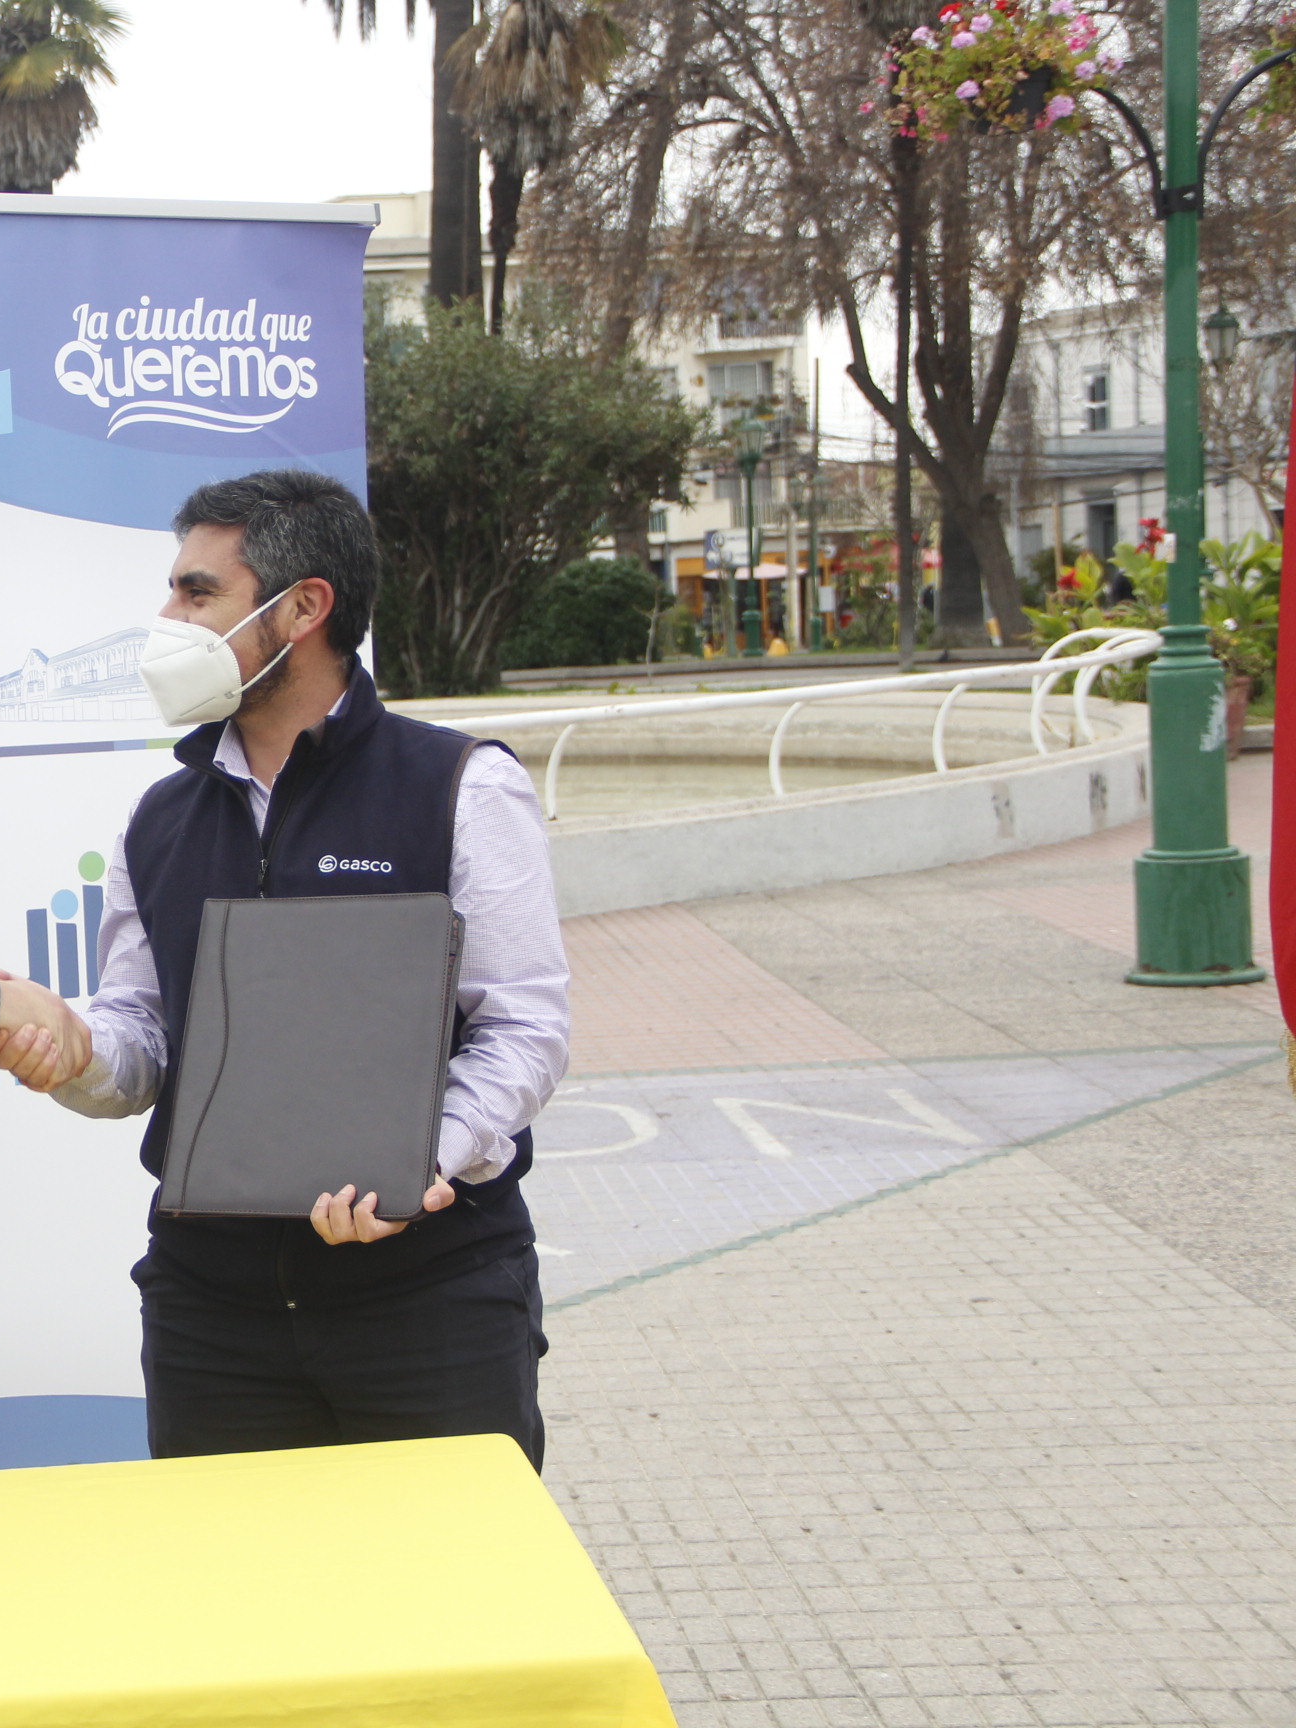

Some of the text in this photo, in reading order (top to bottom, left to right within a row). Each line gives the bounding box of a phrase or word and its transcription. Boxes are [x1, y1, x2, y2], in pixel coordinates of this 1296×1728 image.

[72, 295, 312, 352] La ciudad que
[54, 340, 318, 408] Queremos
